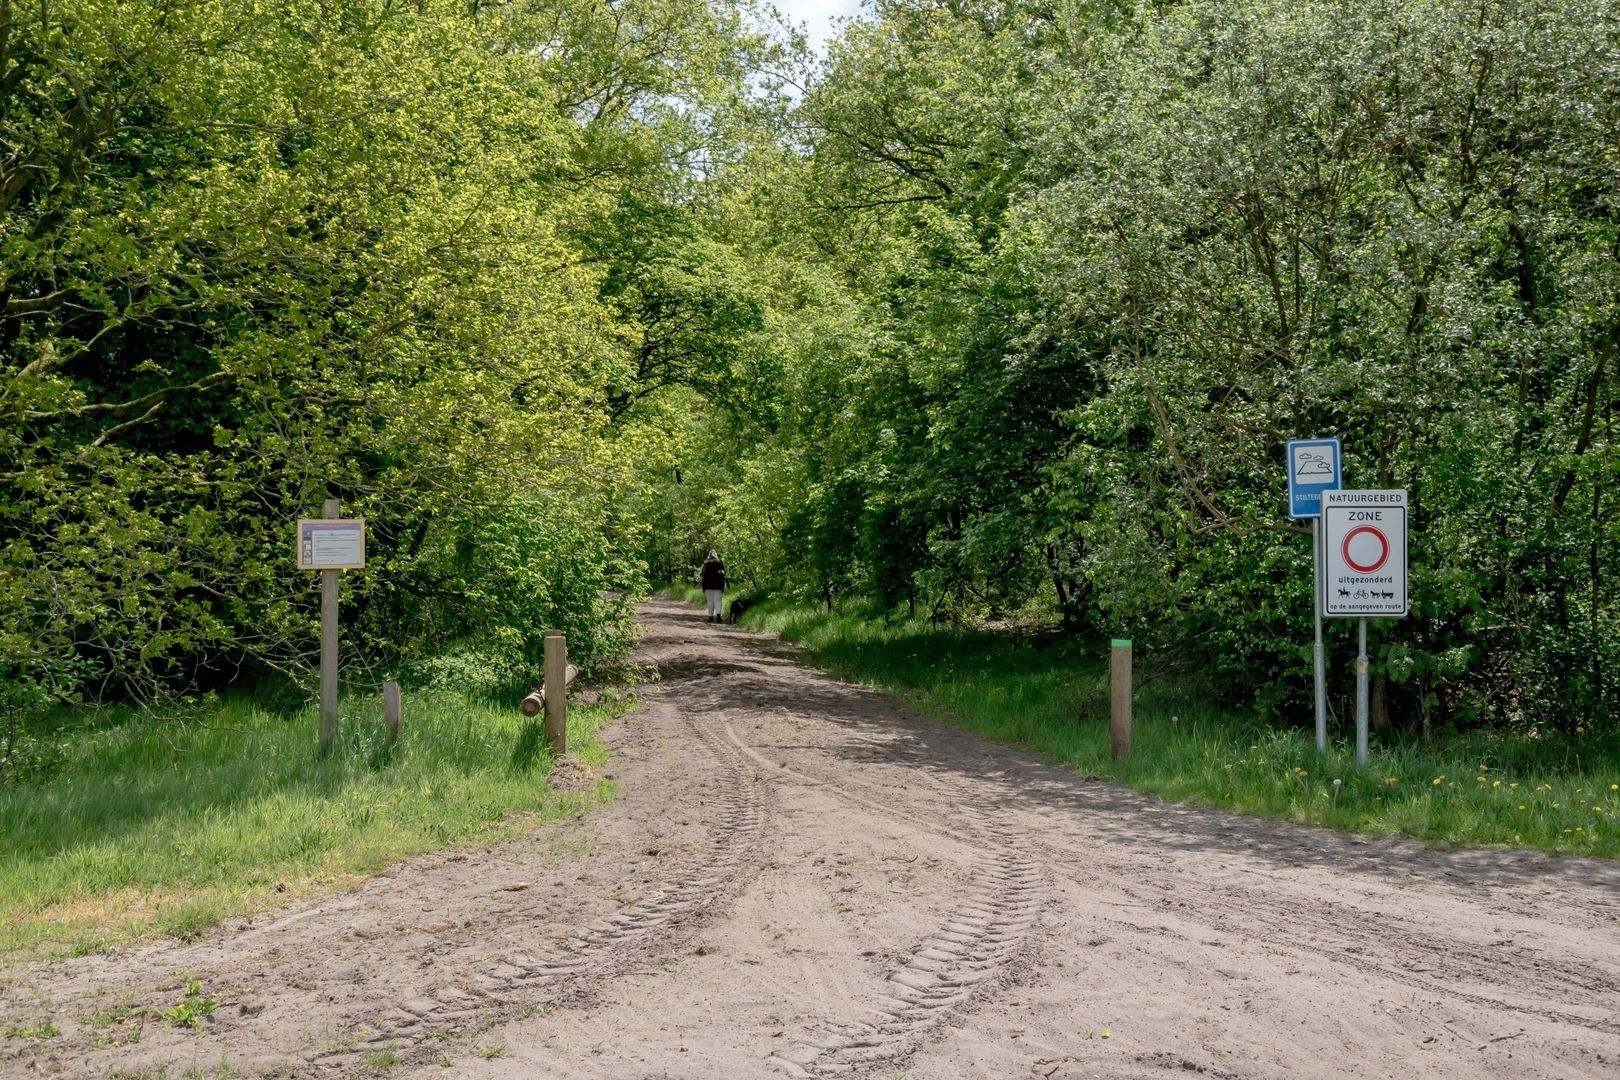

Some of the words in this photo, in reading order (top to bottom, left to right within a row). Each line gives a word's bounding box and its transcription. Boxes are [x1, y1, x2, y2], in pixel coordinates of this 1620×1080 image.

[1329, 494, 1402, 502] NATUURGEBIED
[1348, 511, 1382, 521] ZONE
[1338, 576, 1393, 585] uitgezonderd
